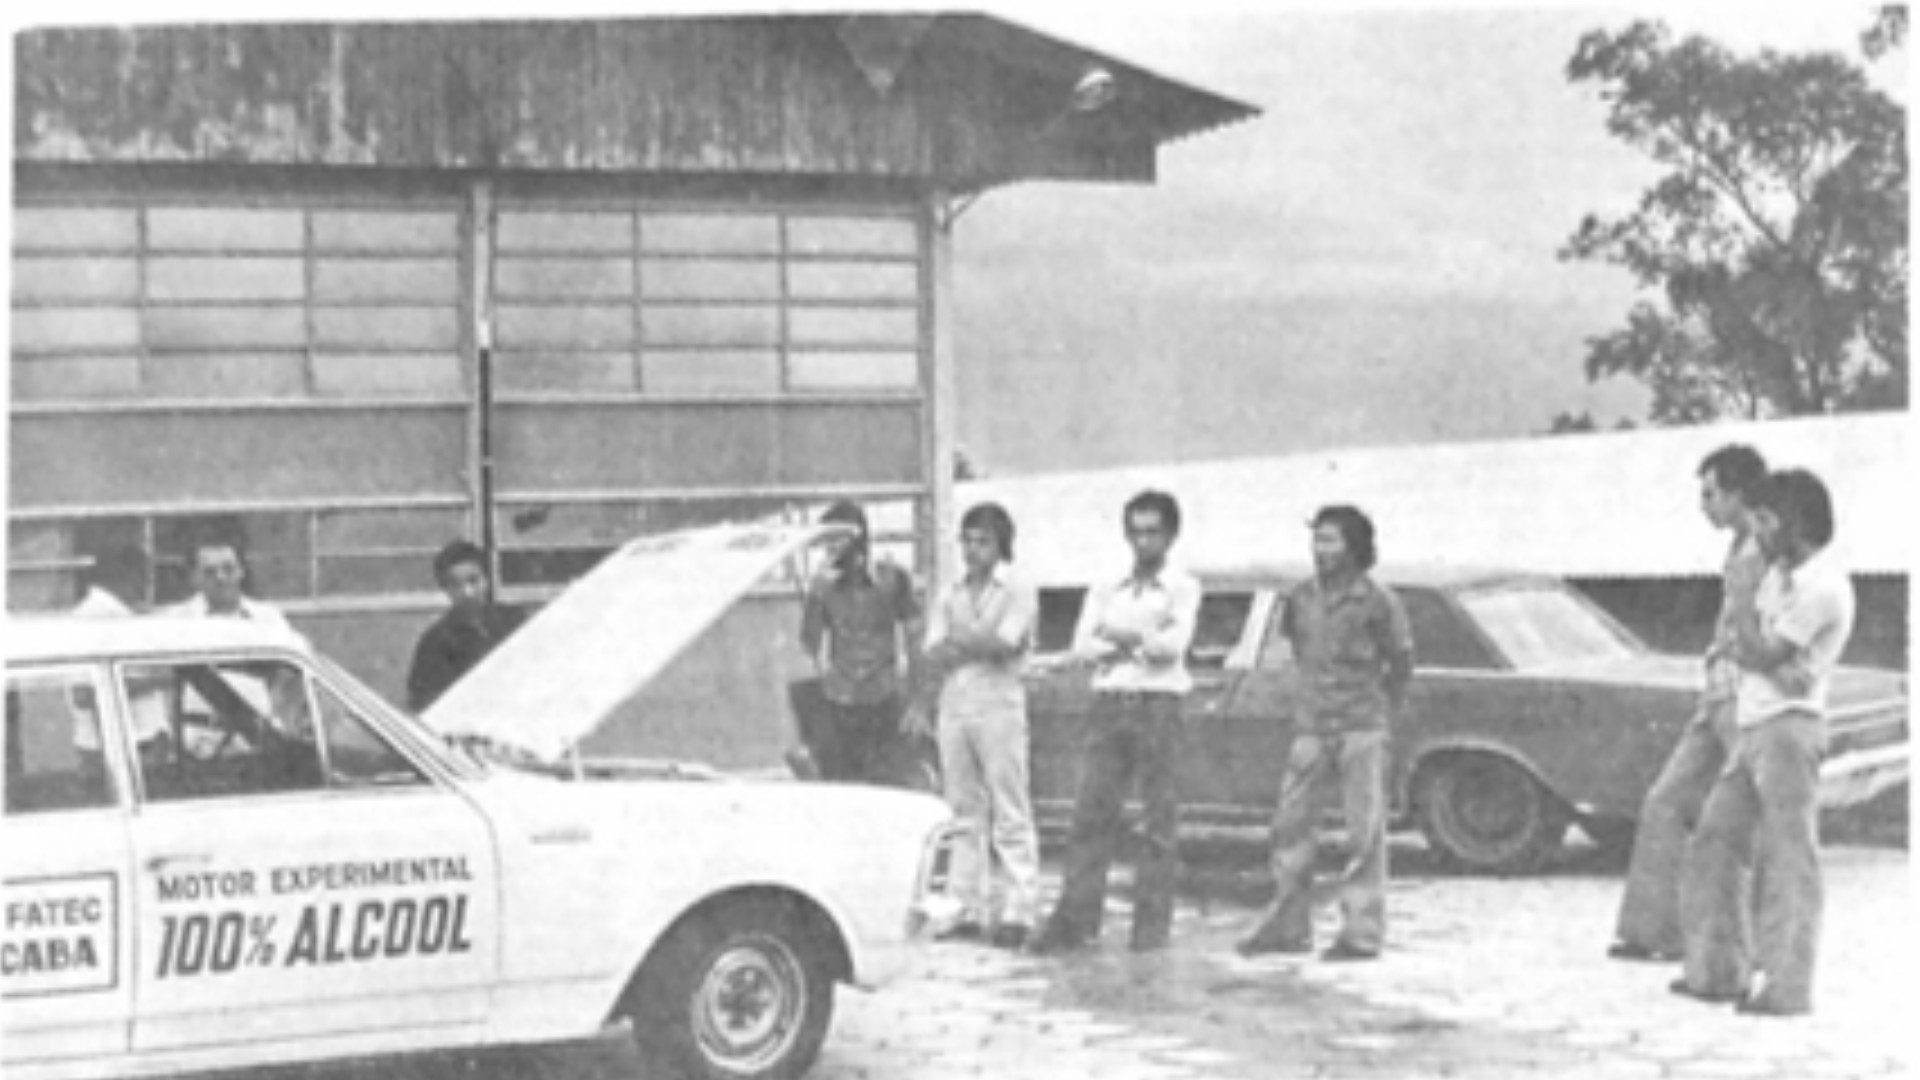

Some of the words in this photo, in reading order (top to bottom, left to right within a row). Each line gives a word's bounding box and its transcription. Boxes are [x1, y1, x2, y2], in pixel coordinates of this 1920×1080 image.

[157, 870, 256, 901] MOTOR
[270, 856, 472, 895] EXPERIMENTAL
[6, 896, 101, 929] FATEC
[0, 935, 98, 976] CABA
[155, 910, 277, 979] 100%
[284, 893, 472, 967] ALCOOL
